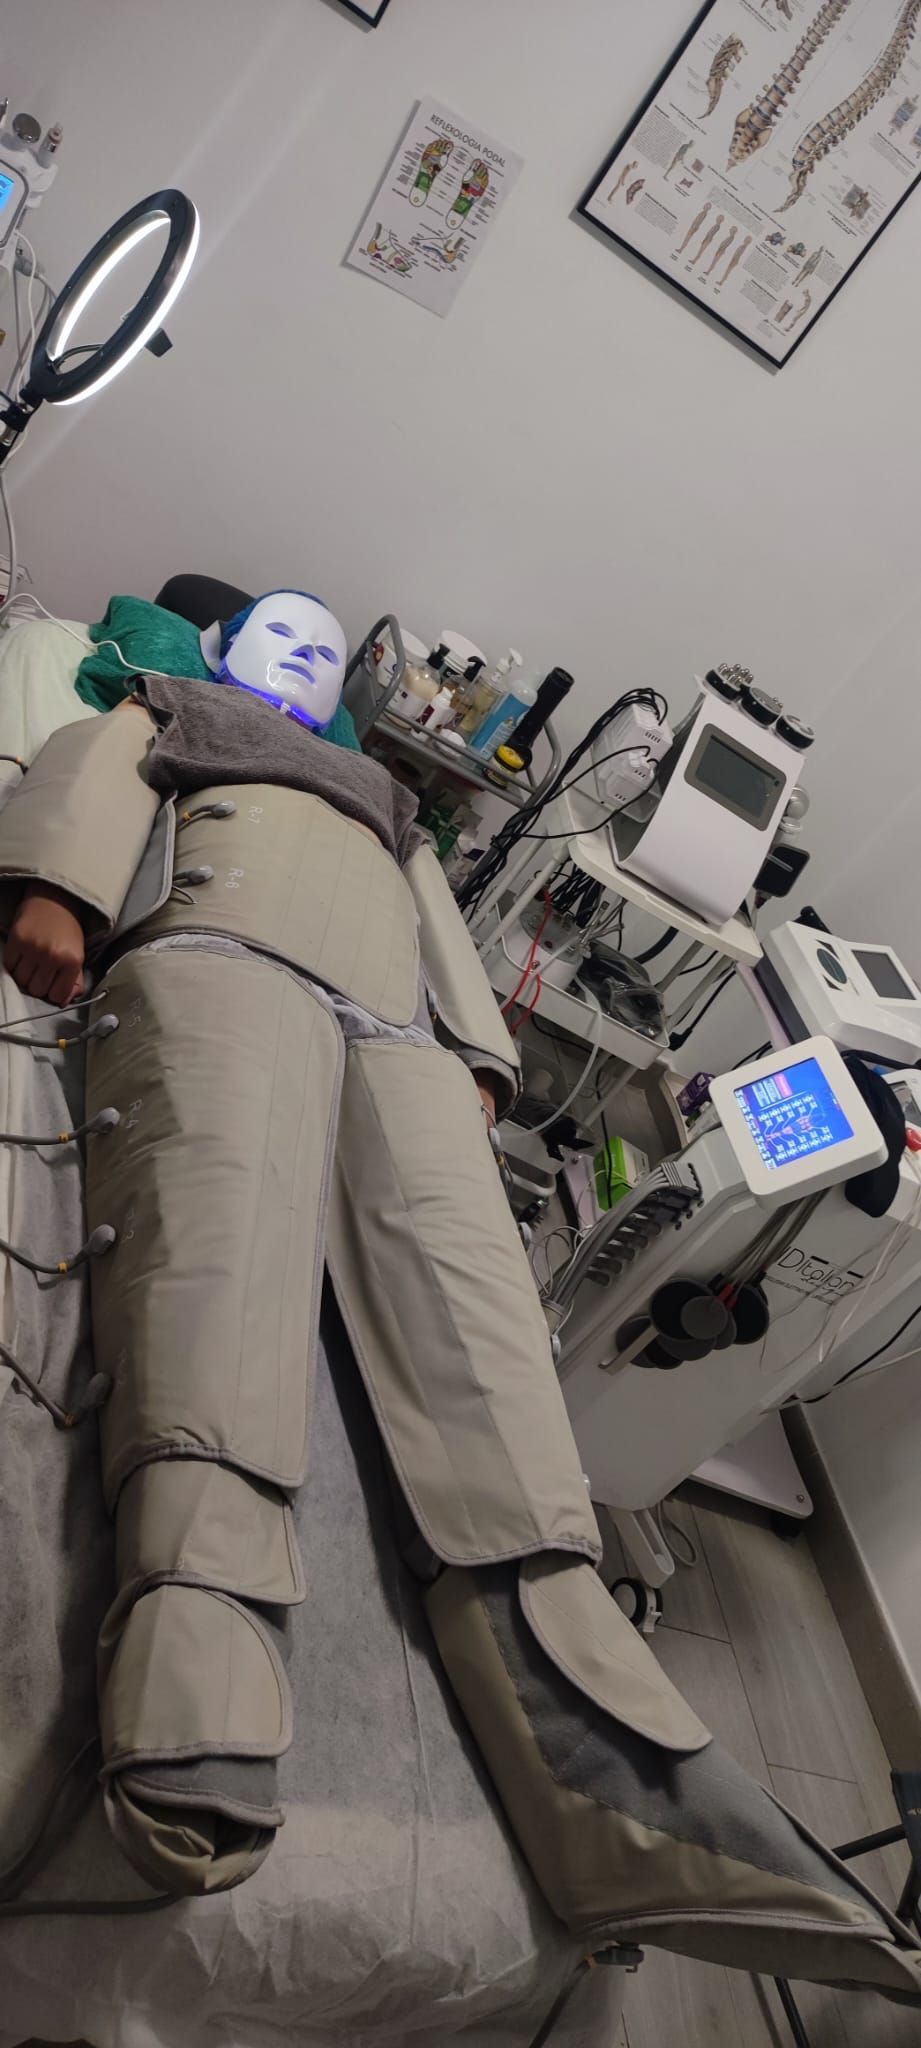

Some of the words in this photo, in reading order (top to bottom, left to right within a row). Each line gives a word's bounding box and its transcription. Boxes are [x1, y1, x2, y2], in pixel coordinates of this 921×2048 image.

[482, 146, 506, 168] PODAL
[248, 805, 264, 824] R-7
[225, 867, 245, 889] R-6
[125, 1099, 143, 1129] R-4
